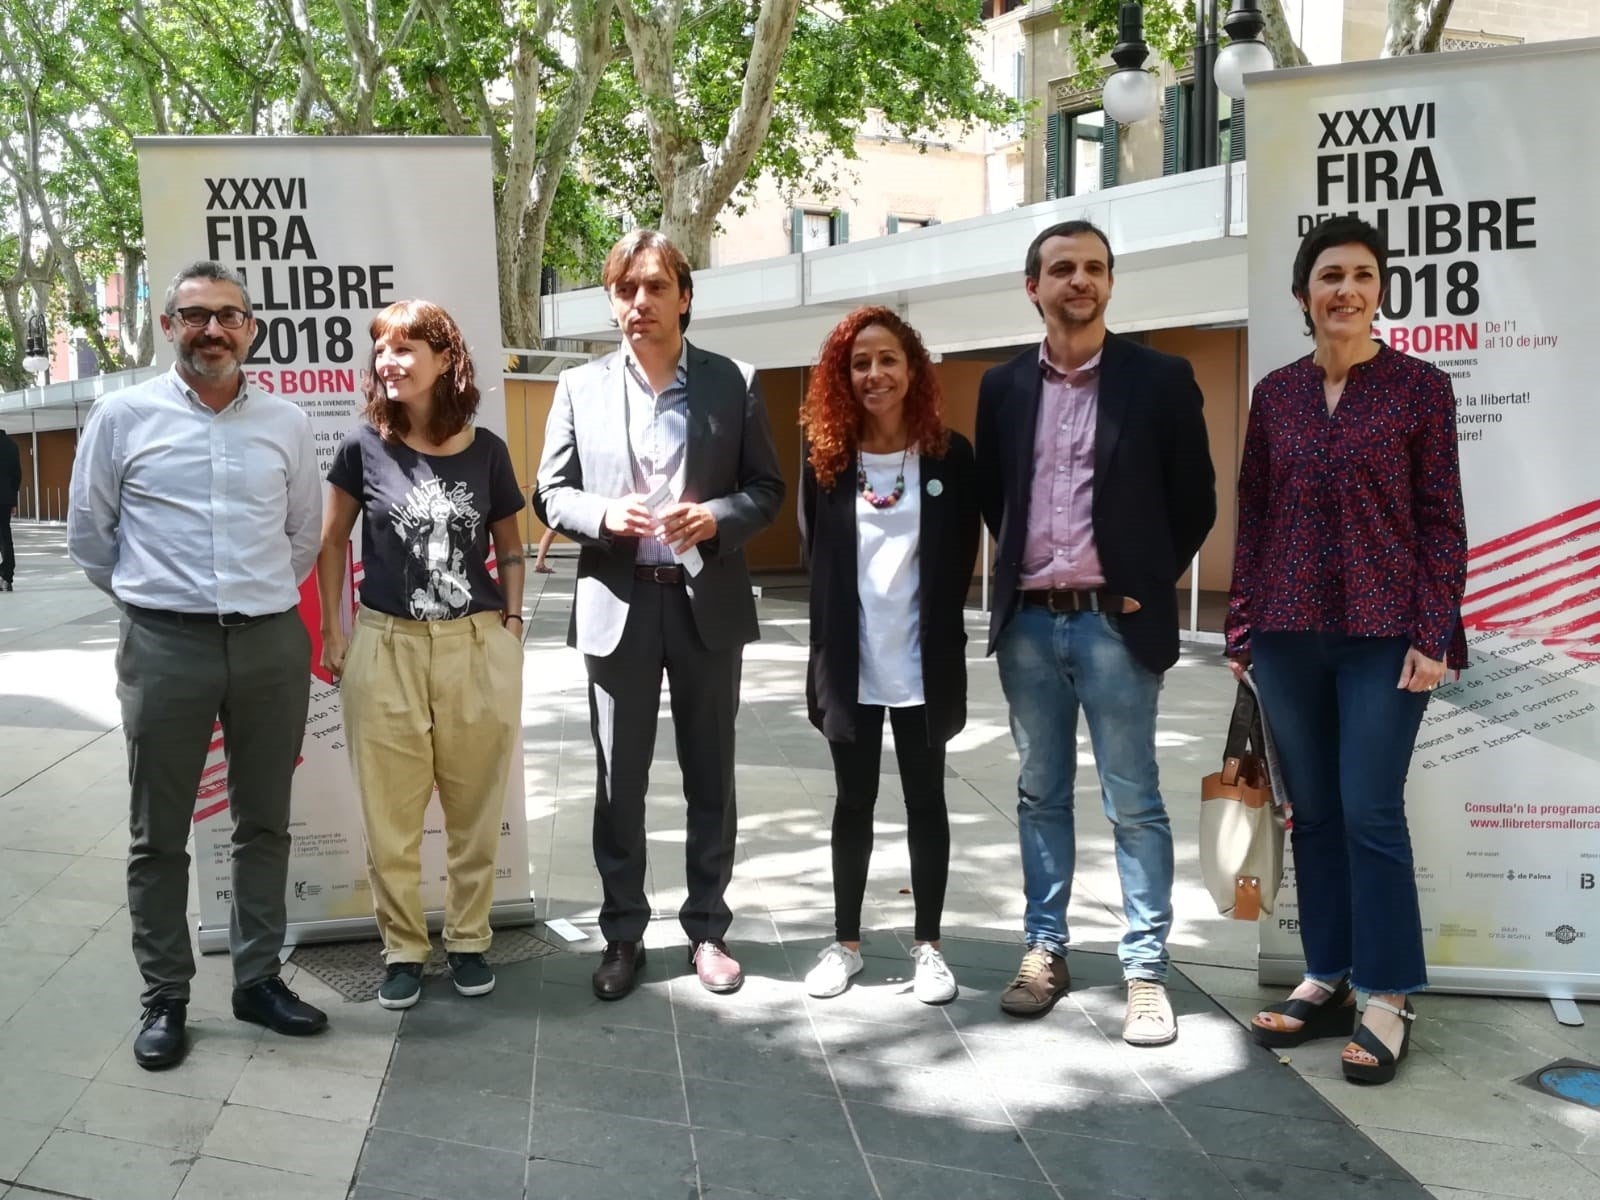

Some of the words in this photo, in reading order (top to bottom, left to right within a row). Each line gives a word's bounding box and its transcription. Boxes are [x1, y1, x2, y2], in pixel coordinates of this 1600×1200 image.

[1317, 102, 1436, 149] XXXVI
[1316, 146, 1444, 206] FIRA
[204, 177, 308, 210] XXXVI
[206, 215, 317, 261] FIRA
[1348, 196, 1537, 259] LIBRE
[1372, 261, 1480, 322] 018
[244, 316, 354, 365] 2018
[1389, 322, 1478, 354] BORN
[1485, 321, 1500, 333] De
[1504, 320, 1516, 332] l'1
[1485, 336, 1495, 348] al
[1499, 336, 1513, 348] 10
[1517, 335, 1530, 347] de
[1533, 335, 1558, 349] juny
[1438, 359, 1478, 367] DIVENDRES
[280, 369, 355, 394] BORN
[1466, 394, 1477, 406] la
[1481, 392, 1531, 406] llibertat!
[1456, 430, 1483, 442] aire!
[1467, 680, 1484, 689] de
[1496, 690, 1513, 700] de
[1514, 684, 1534, 694] la
[1457, 726, 1474, 735] de
[1522, 689, 1579, 712] Governo
[1422, 760, 1440, 769] el
[1441, 745, 1481, 763] furor
[1483, 728, 1531, 748] incert
[1534, 721, 1551, 730] de
[1464, 802, 1524, 814] Consulta'n
[1527, 803, 1537, 814] la
